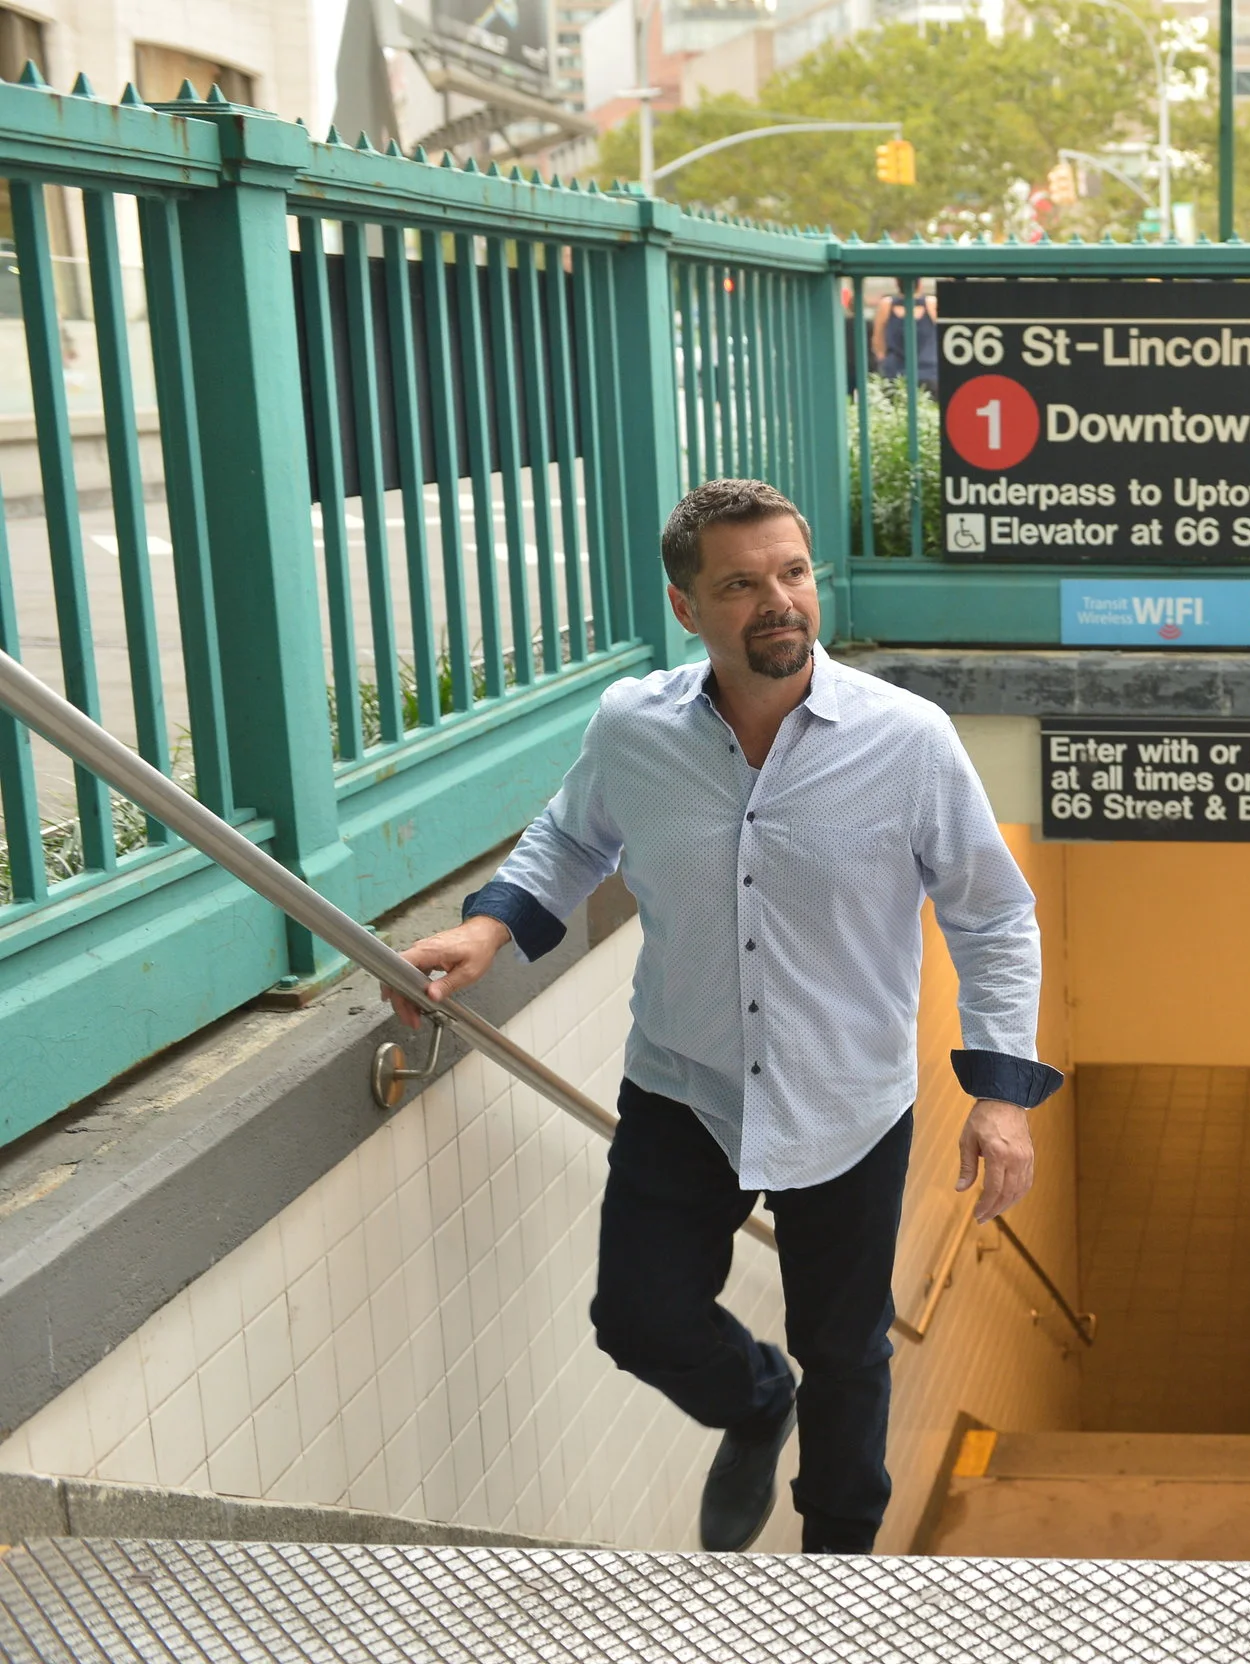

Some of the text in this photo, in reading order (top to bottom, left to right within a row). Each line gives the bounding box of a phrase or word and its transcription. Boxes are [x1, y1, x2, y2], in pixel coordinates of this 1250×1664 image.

[943, 325, 1003, 366] 66
[975, 399, 1001, 449] 1
[945, 476, 1115, 511] Underpass
[1129, 479, 1161, 507] to
[991, 517, 1118, 546] Elevator
[1131, 518, 1162, 546] at
[1175, 517, 1219, 546] 66
[1083, 596, 1128, 610] Transit
[1078, 612, 1133, 625] Wireless
[1050, 737, 1127, 764] Enter
[1137, 738, 1198, 765] with
[1210, 745, 1241, 765] or
[1051, 770, 1080, 791] at
[1092, 768, 1122, 791] all
[1134, 769, 1213, 792] times
[1051, 794, 1092, 820] 66
[1103, 793, 1194, 821] Street
[1205, 795, 1227, 821] &
